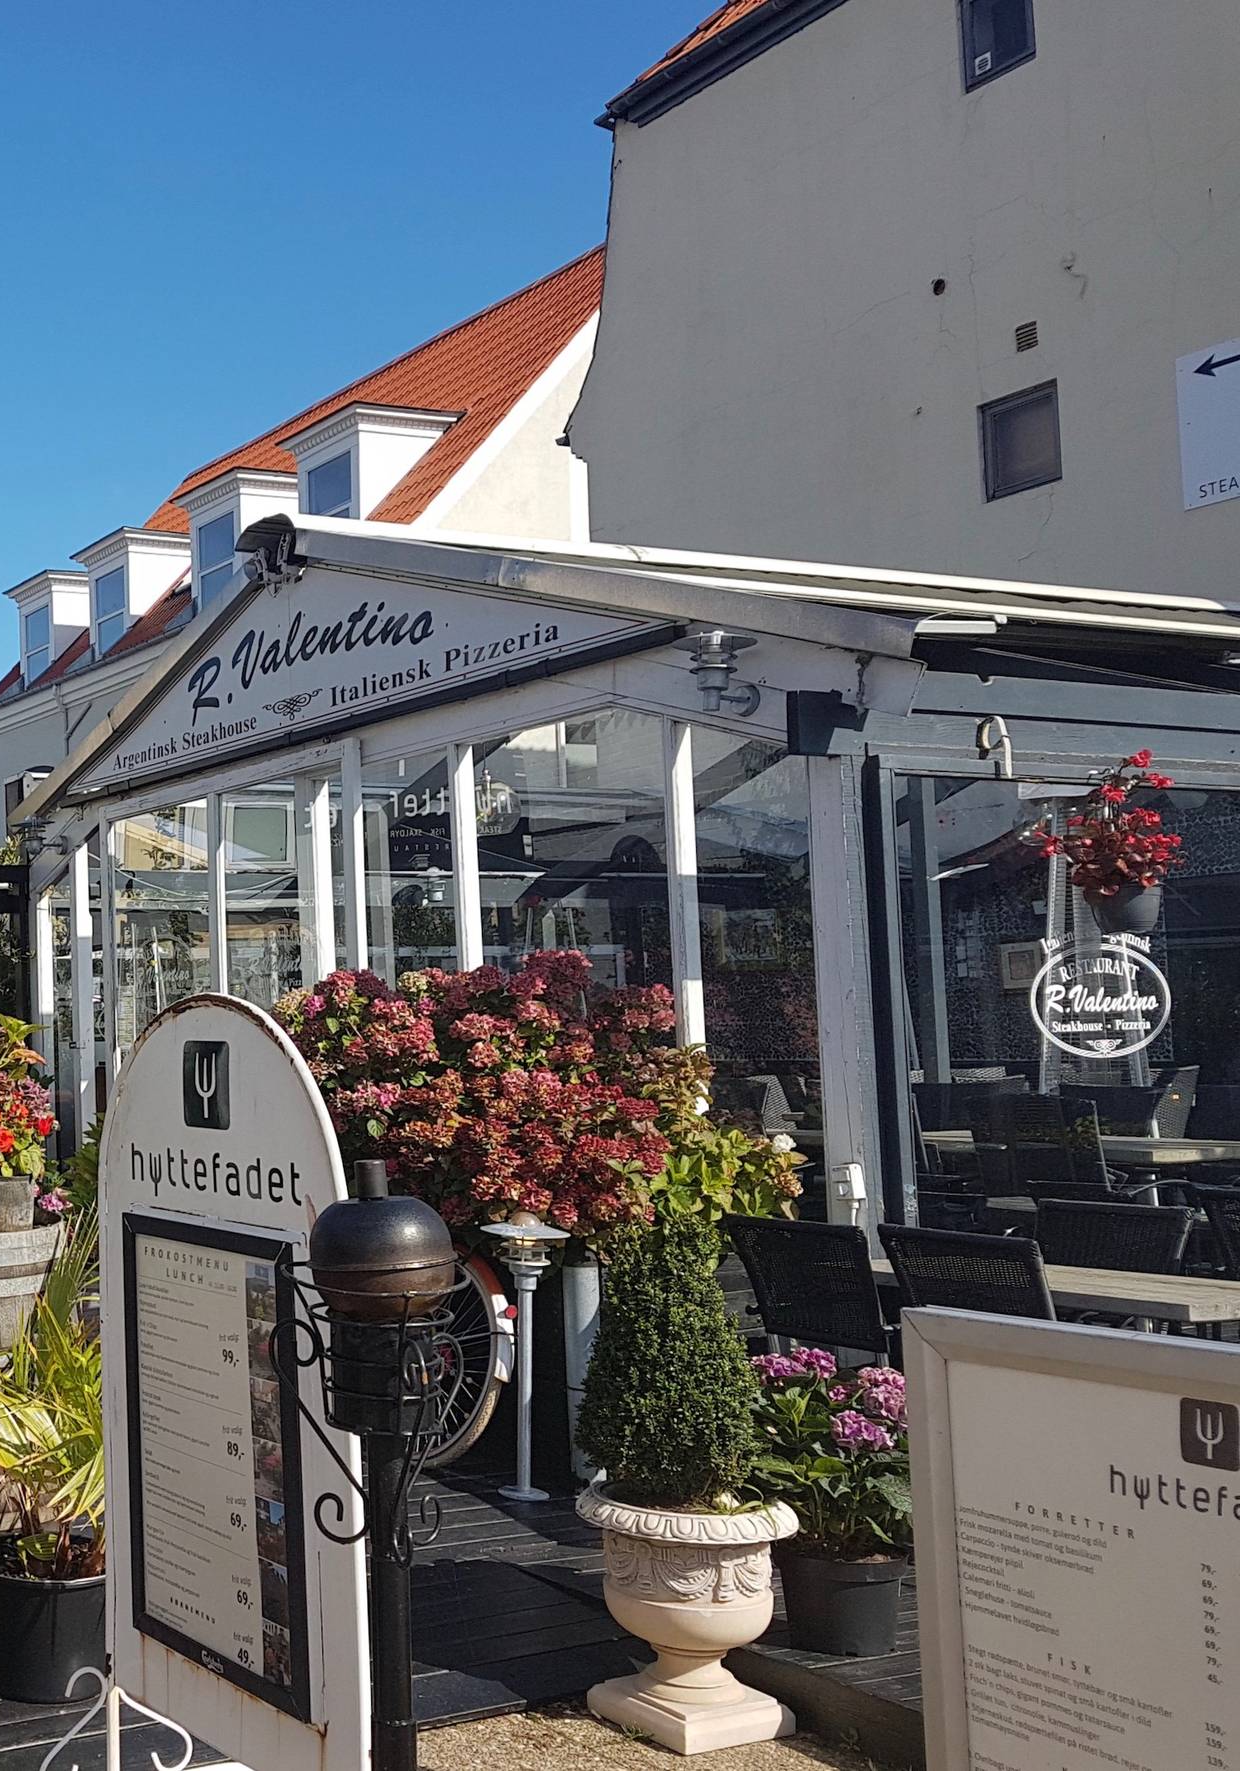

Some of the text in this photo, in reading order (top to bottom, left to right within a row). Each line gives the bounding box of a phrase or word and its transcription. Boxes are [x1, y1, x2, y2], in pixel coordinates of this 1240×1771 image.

[1199, 476, 1240, 498] STEA
[113, 623, 560, 770] Argentinsk Steakhouse Italiensk Pizzeria
[1060, 958, 1140, 982] RESTAURANT
[1052, 1018, 1151, 1032] Steakhouse Pizzeria
[131, 1142, 302, 1206] hyttefadet
[144, 1246, 229, 1272] FROKOSTMENU
[166, 1268, 204, 1284] LUNCH
[222, 1348, 240, 1368] 99,-
[227, 1440, 244, 1460] 89,-
[1110, 1464, 1240, 1521] hyttef
[230, 1512, 247, 1532] 69,-
[1016, 1502, 1134, 1540] FORRETTER
[236, 1590, 254, 1610] 69,-
[237, 1648, 254, 1668] 49,-
[1048, 1652, 1091, 1675] FISK
